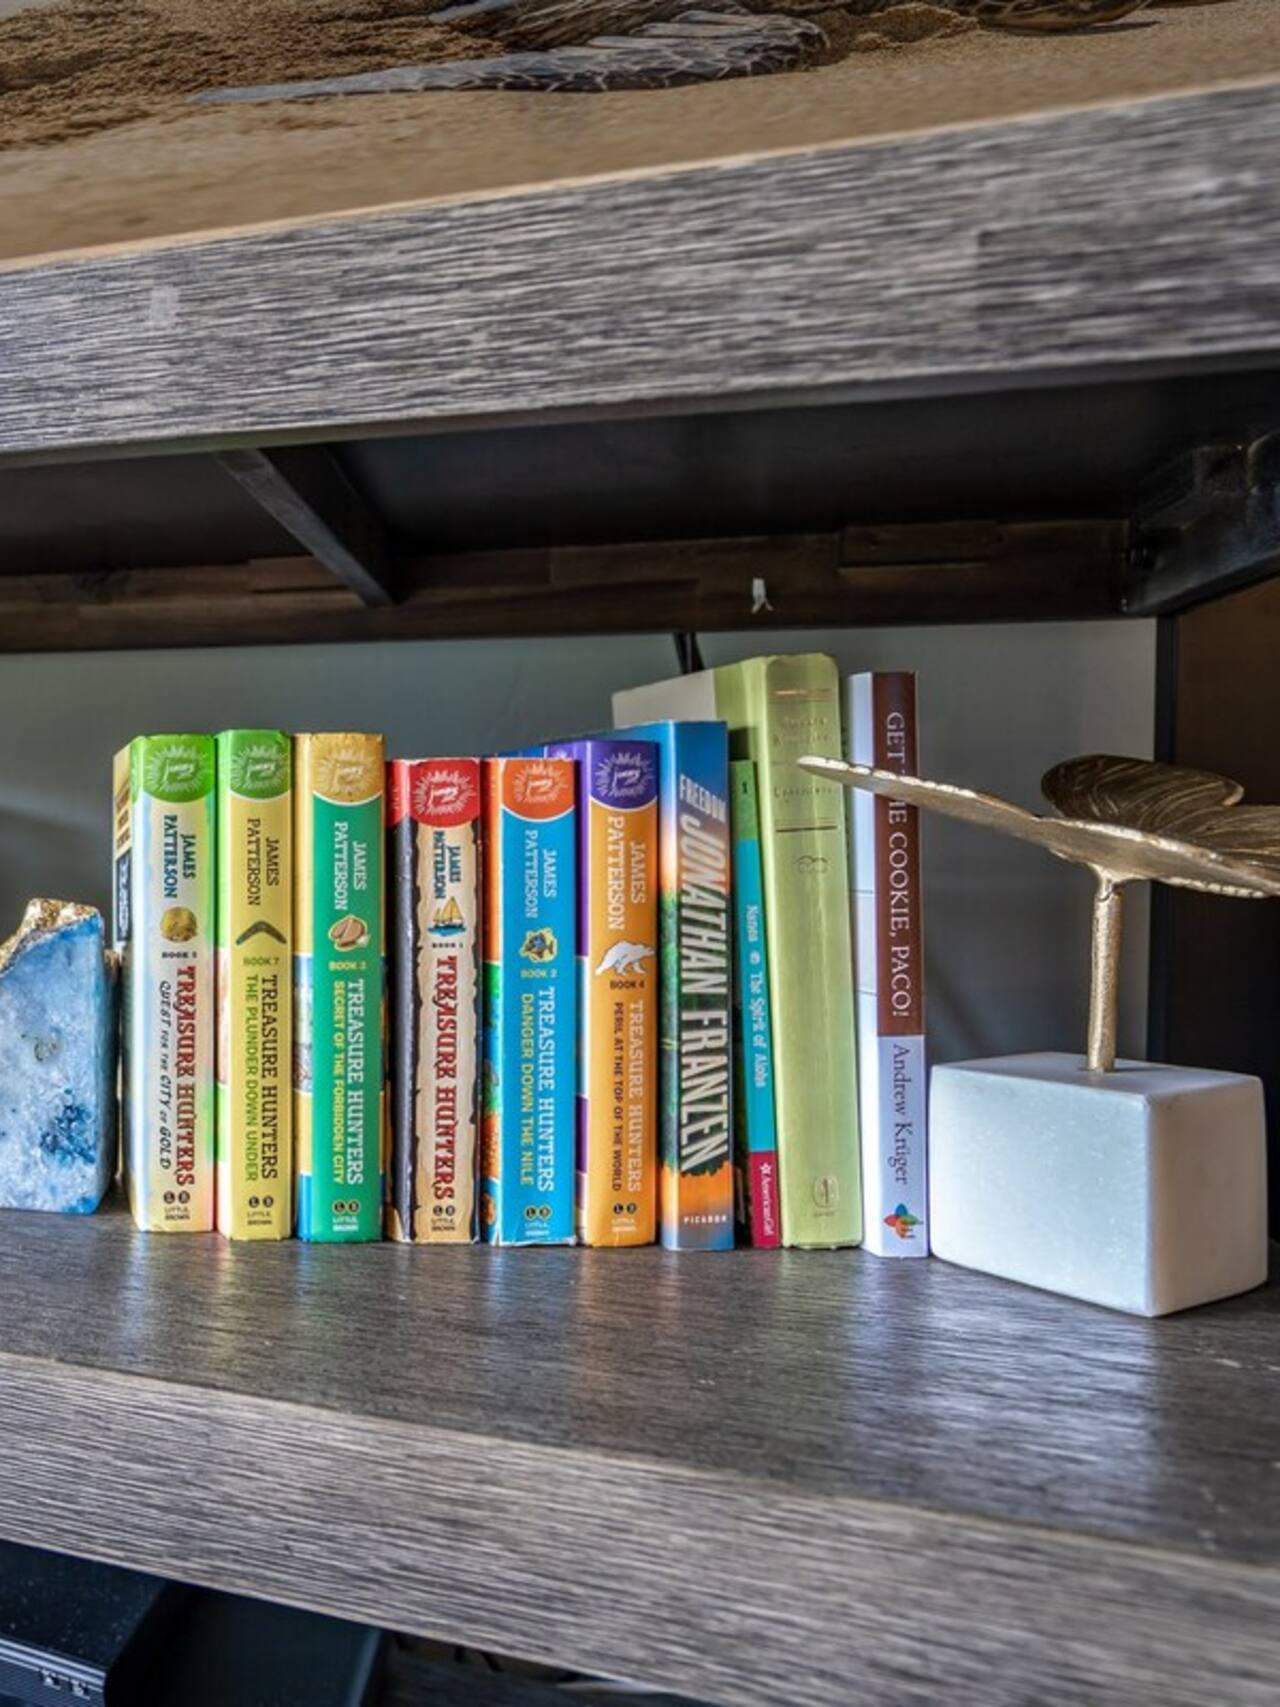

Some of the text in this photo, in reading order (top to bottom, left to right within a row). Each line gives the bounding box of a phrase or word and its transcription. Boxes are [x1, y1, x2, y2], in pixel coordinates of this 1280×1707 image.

[887, 712, 905, 763] GET
[679, 774, 727, 823] FREEDOM
[163, 814, 178, 899] PATTERSON
[181, 834, 197, 880] JAMES
[247, 818, 261, 906] PATTERSON
[266, 837, 279, 887] JAMES
[334, 821, 349, 910] PATTERSON
[353, 841, 367, 891] JAMES
[524, 829, 539, 919] PATTERSON
[543, 849, 558, 898] JAMES
[607, 815, 626, 931] PATTERSON
[630, 841, 646, 904] JAMES
[889, 831, 910, 938] COOKIE,
[162, 951, 189, 959] BOOK
[243, 957, 270, 966] BOOK
[328, 961, 357, 971] BOOK
[610, 980, 637, 990] BOOK
[680, 812, 729, 1172] JONATHAN FRANZEN
[891, 946, 911, 1017] PACO!
[159, 980, 171, 1027] QUEST
[538, 985, 556, 1091] TREASURE
[160, 1075, 171, 1110] CITY
[173, 966, 197, 1187] TREASURE HUNTERS
[245, 974, 258, 1181] THE PLUNDER DOWN UNDER
[261, 974, 278, 1179] TREASURE HUNTERS
[333, 980, 345, 1185] SECRET OF THE FORBIDDEN CITY
[347, 978, 364, 1185] TREASURE HUNTERS
[432, 955, 458, 1200] TREASURE HUNTERS
[520, 993, 534, 1186] DANGER DOWN THE NILE
[612, 1002, 624, 1192] PERIL AT THE TOP OF THE WORLD
[628, 1000, 644, 1193] TREASURE HUNTERS
[892, 1043, 912, 1117] Andrew
[159, 1128, 172, 1170] GOLD
[537, 1097, 555, 1192] HUNTERS
[684, 1215, 727, 1224] PICADOR
